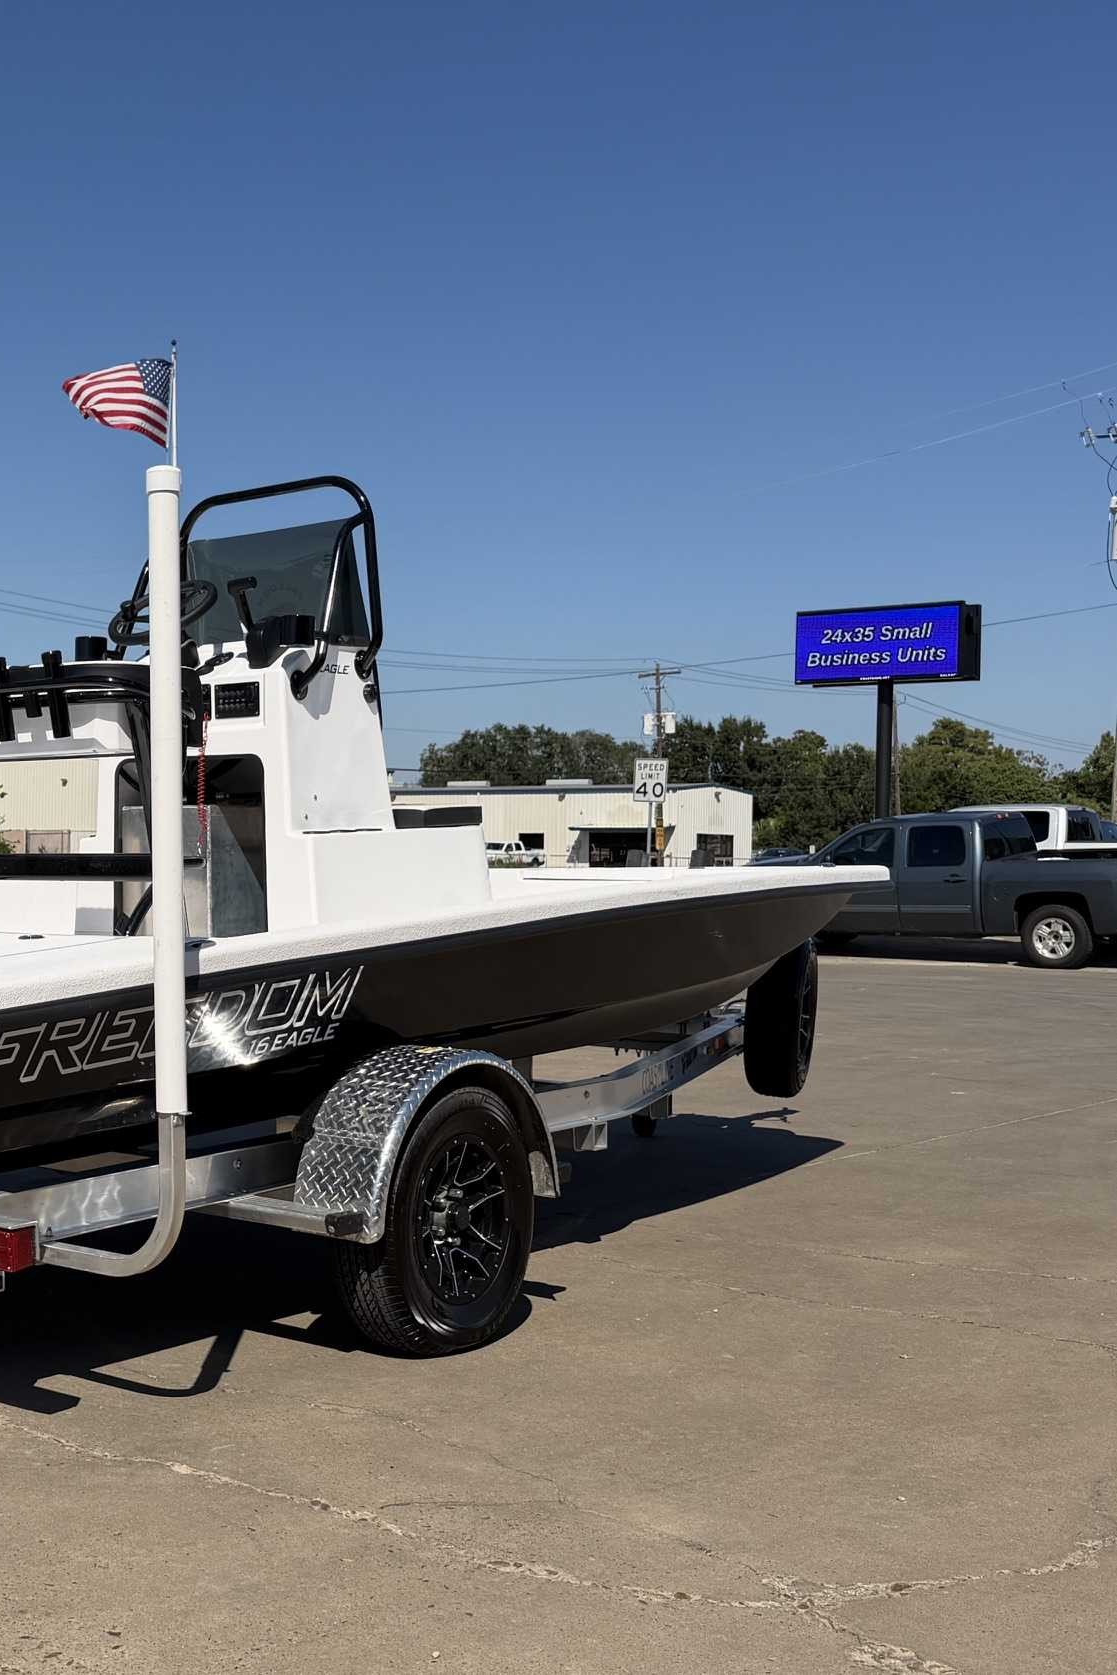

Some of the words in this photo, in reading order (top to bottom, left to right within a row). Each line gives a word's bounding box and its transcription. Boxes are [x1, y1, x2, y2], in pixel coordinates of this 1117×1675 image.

[821, 627, 875, 645] 24x35
[879, 622, 933, 641] Small
[807, 650, 891, 667] Business
[897, 646, 947, 663] Units
[320, 664, 350, 675] AGLE
[637, 763, 664, 771] SPEED
[636, 781, 664, 798] 40
[247, 1036, 271, 1057] 16
[270, 1022, 341, 1052] EAGLE
